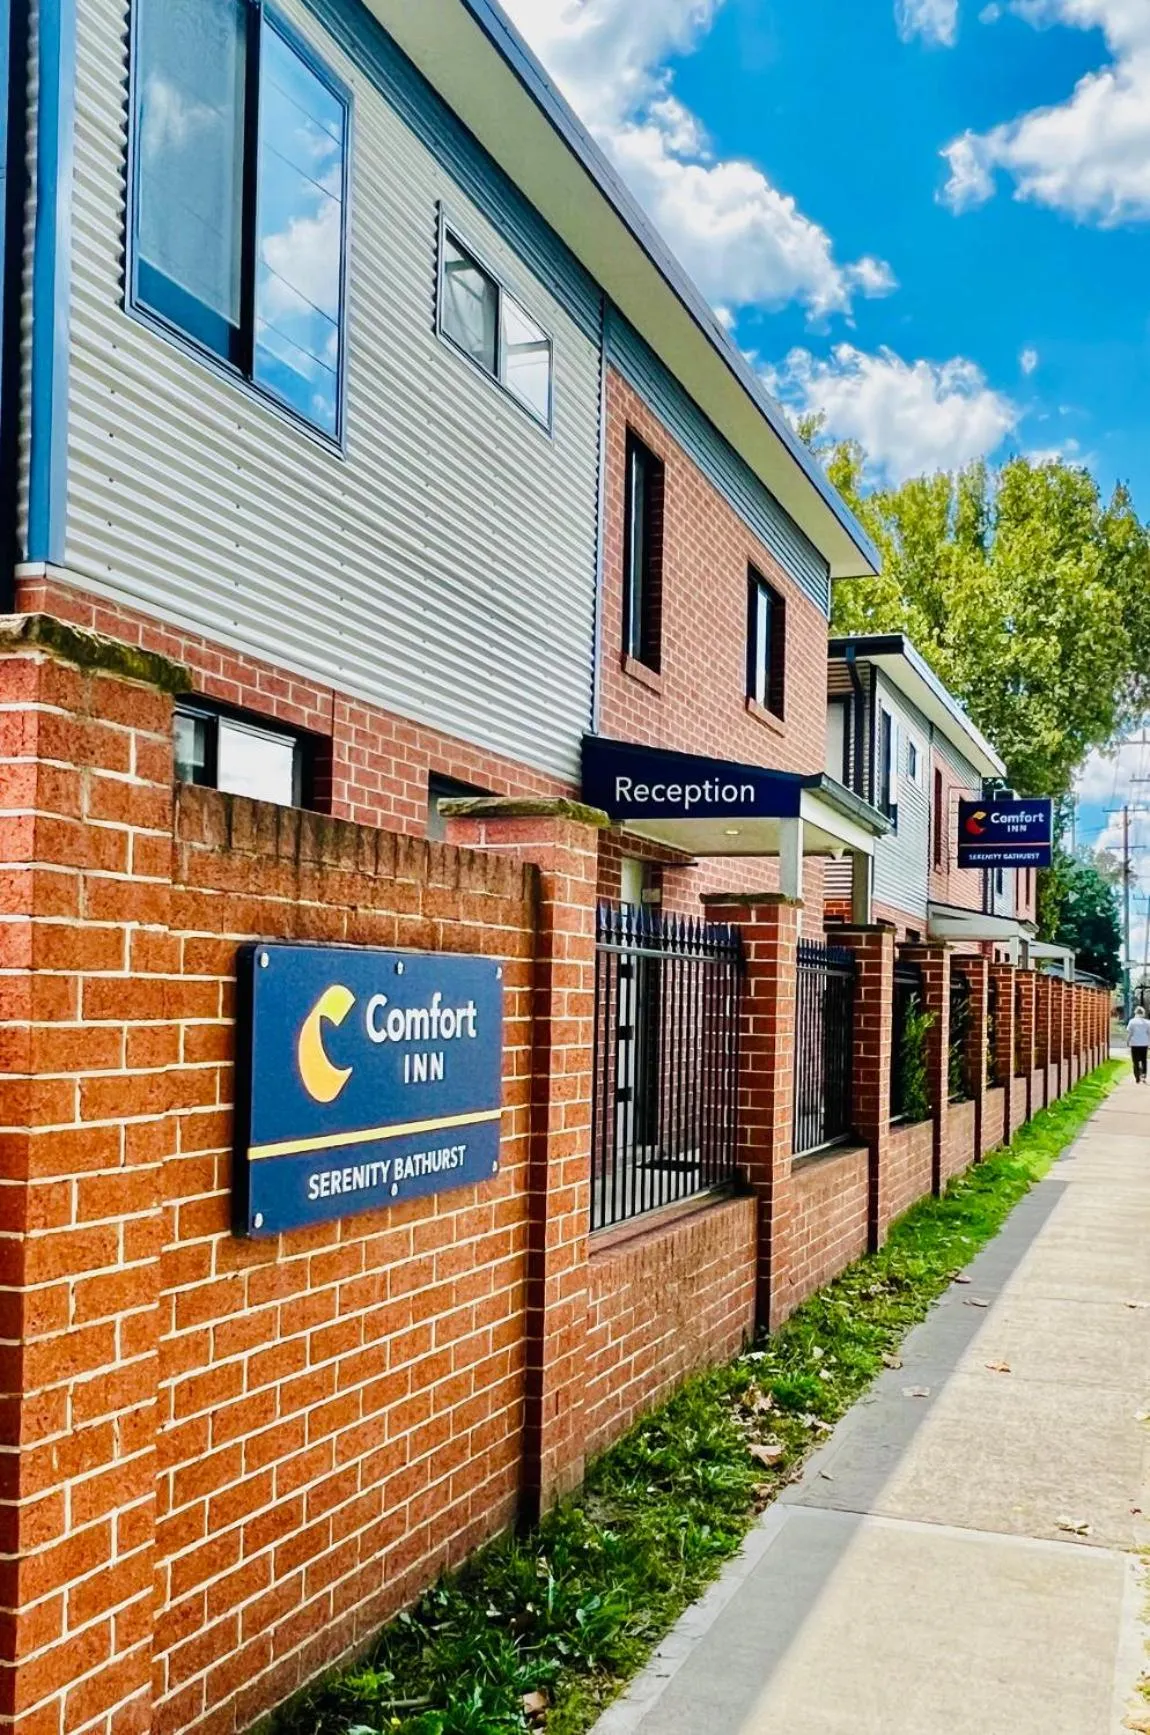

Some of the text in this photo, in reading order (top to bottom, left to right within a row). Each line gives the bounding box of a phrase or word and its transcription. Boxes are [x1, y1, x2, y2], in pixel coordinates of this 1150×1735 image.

[615, 776, 755, 810] Reception
[990, 811, 1045, 823] Comfort
[1007, 824, 1027, 833] INN
[365, 992, 478, 1043] Comfort
[403, 1051, 444, 1084] INN
[307, 1145, 467, 1201] SERENITY BATHURST
